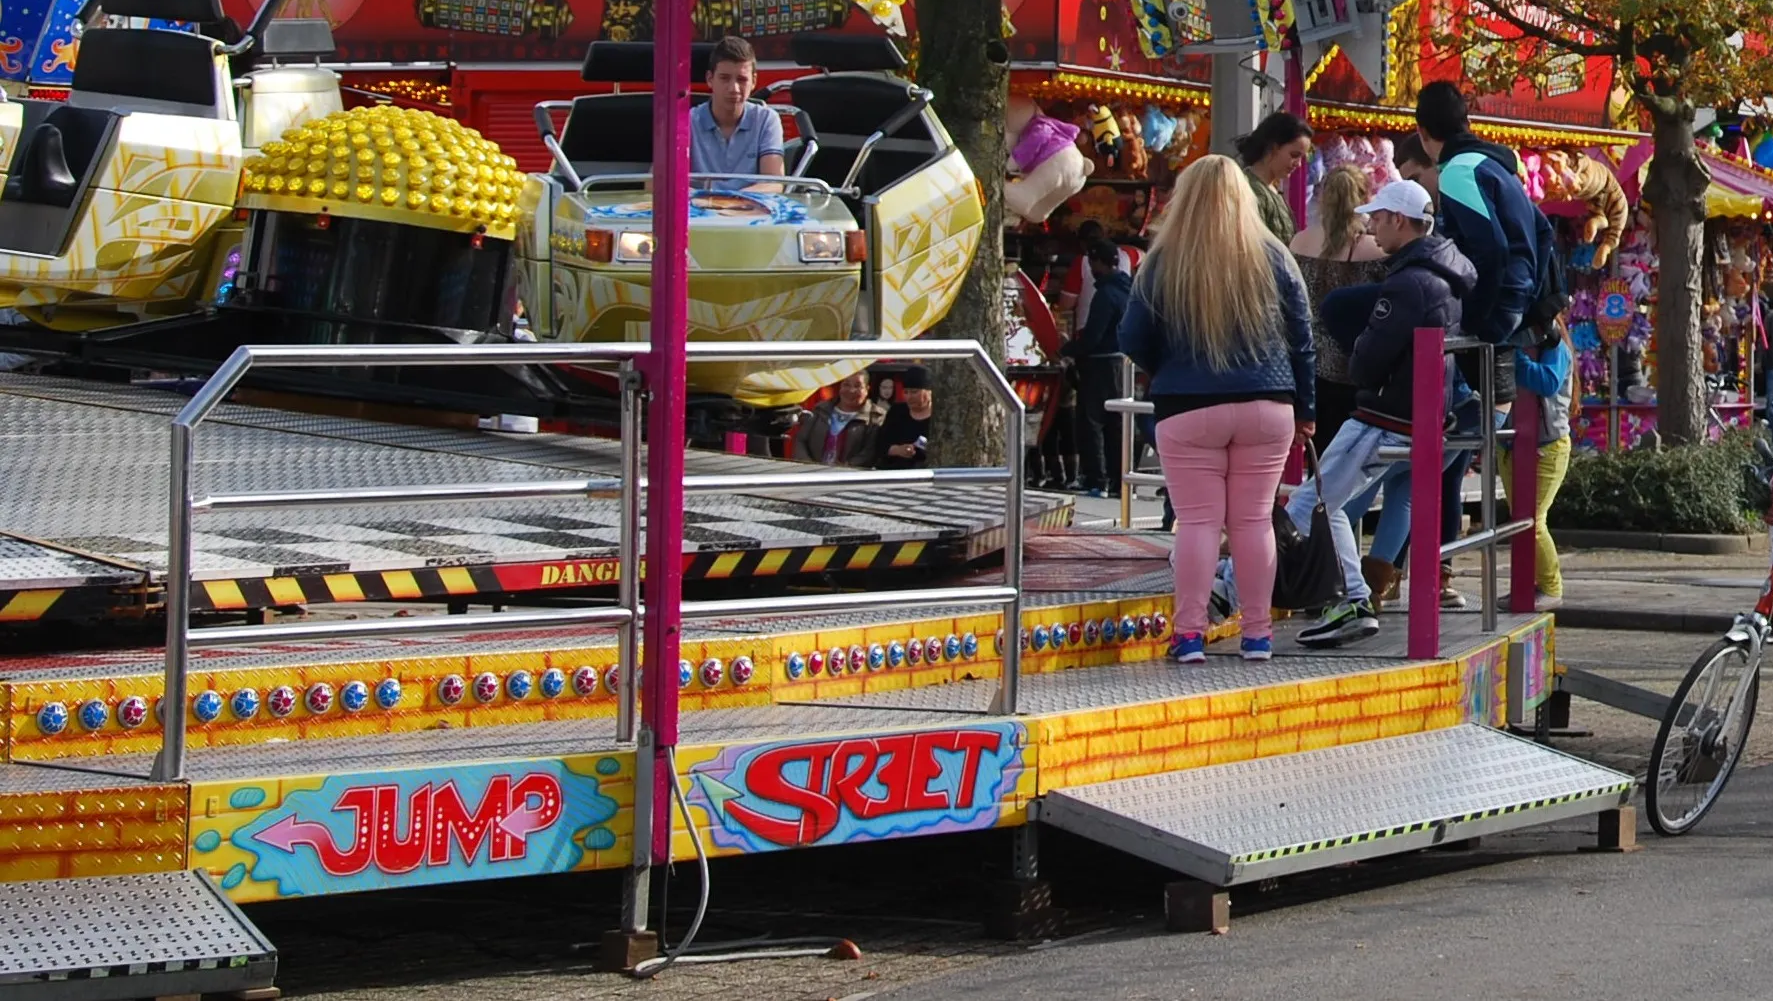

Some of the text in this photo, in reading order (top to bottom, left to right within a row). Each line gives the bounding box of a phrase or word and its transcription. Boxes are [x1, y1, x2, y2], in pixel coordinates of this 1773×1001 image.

[1605, 294, 1626, 317] 8
[541, 560, 647, 586] DANG
[314, 772, 564, 876] JUMP
